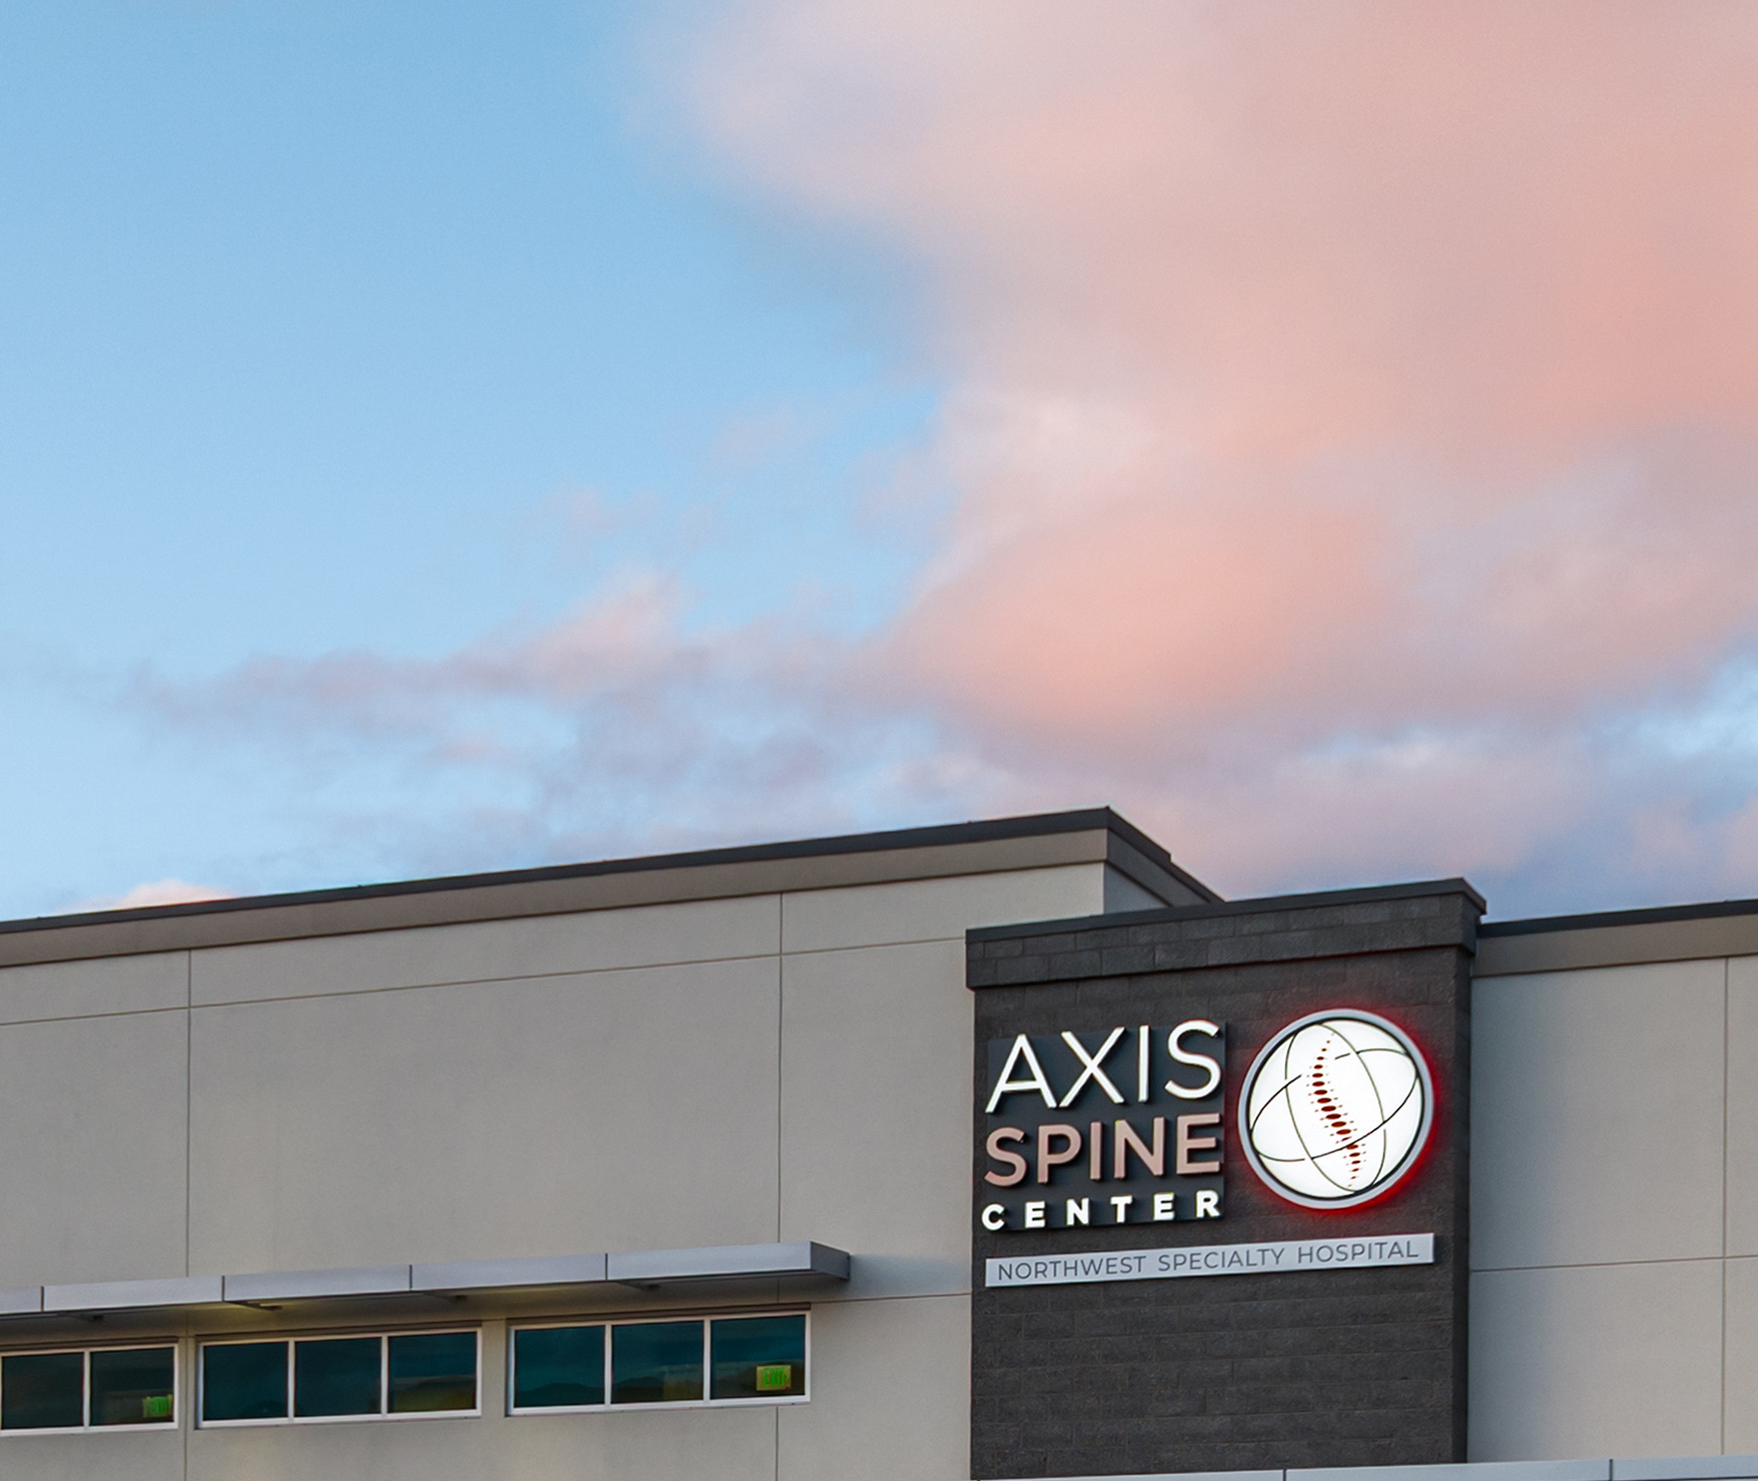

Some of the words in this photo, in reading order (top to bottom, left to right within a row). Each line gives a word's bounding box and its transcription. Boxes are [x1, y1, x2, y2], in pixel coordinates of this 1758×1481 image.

[985, 1019, 1222, 1113] AXIS
[984, 1112, 1221, 1187] SPINE
[981, 1189, 1221, 1231] CENTER
[997, 1255, 1147, 1282] NORTHWEST
[1157, 1247, 1286, 1274] SPECIALTY
[1295, 1240, 1420, 1265] HOSPITAL
[763, 1367, 785, 1387] EXIT
